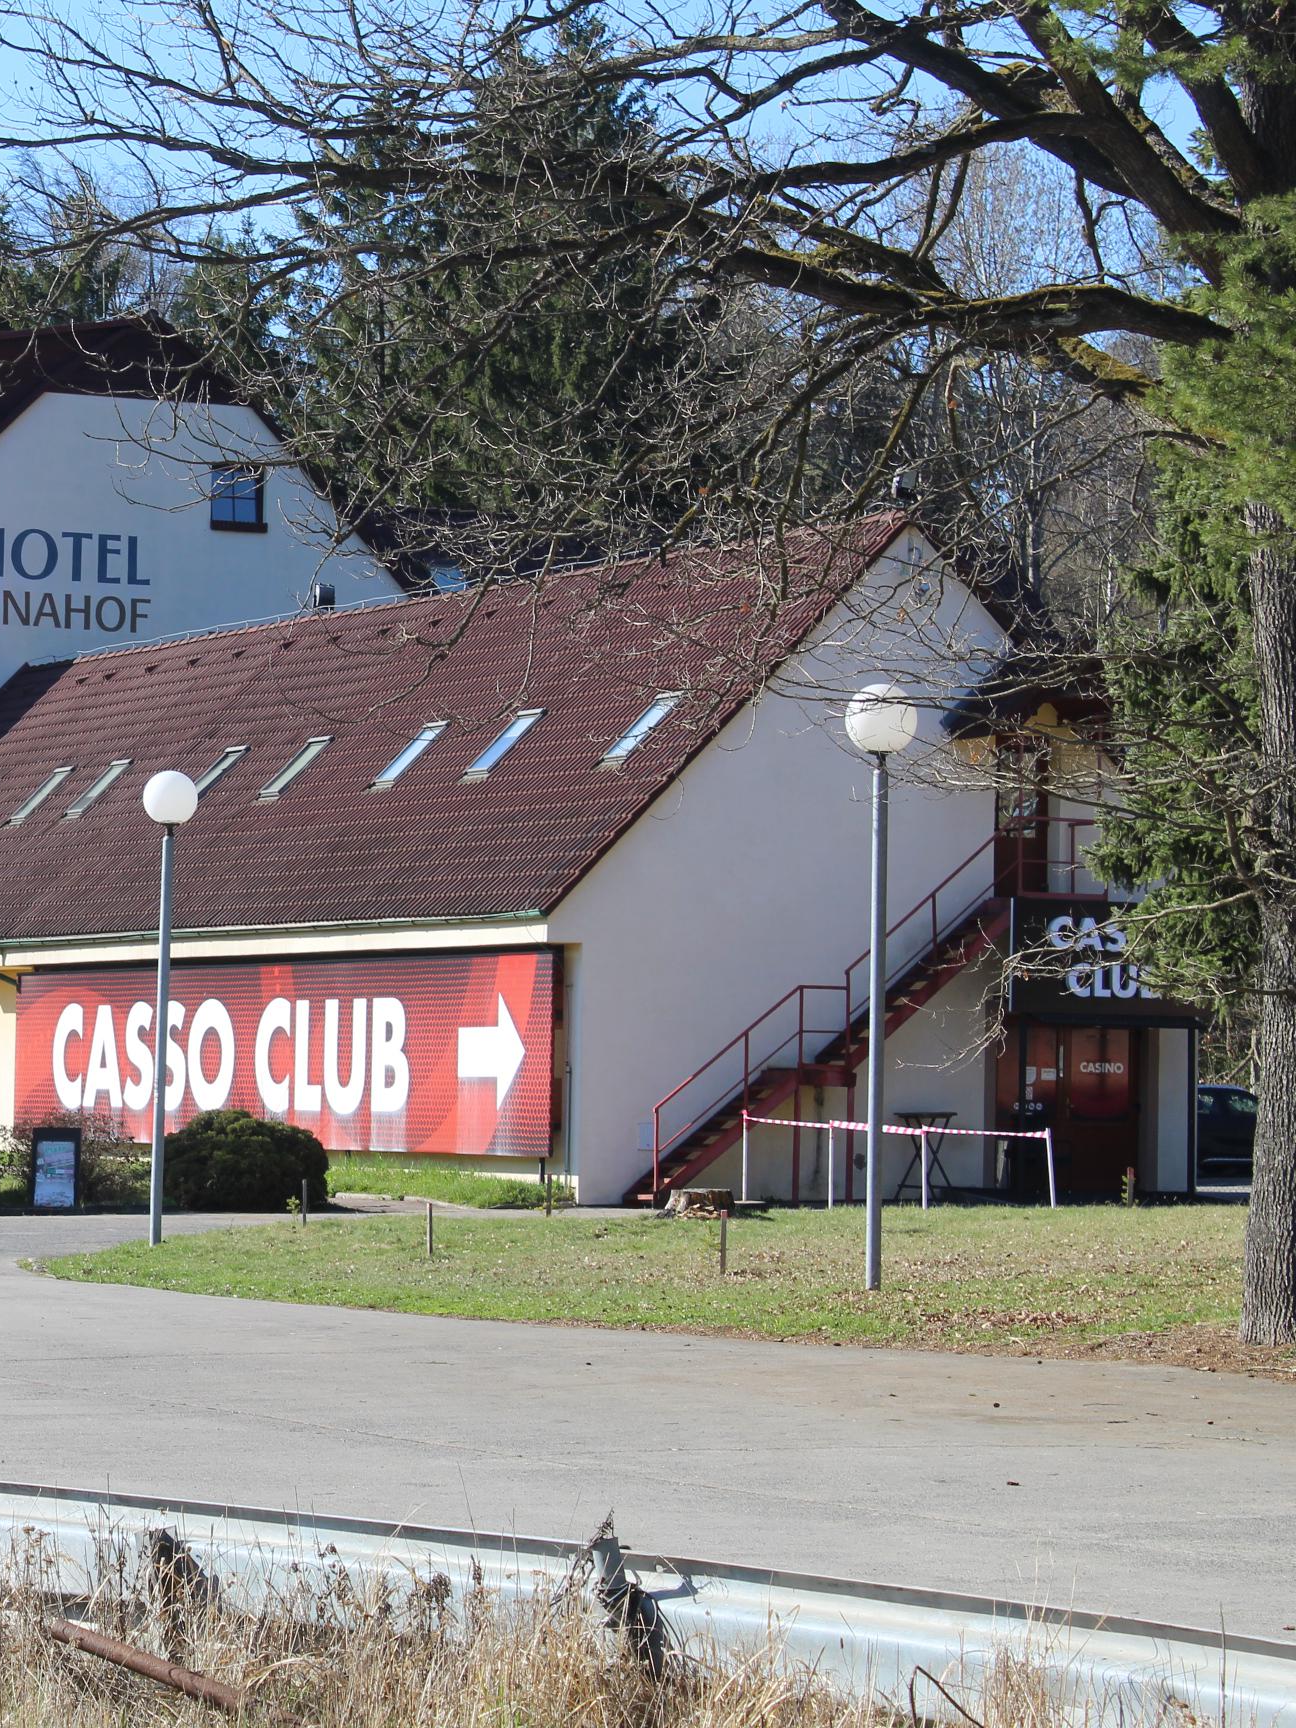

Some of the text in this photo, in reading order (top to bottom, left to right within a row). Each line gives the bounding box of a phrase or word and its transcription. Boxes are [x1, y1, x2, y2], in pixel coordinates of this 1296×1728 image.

[52, 997, 410, 1115] CASSO CLUB
[1079, 1062, 1124, 1074] CASINO
